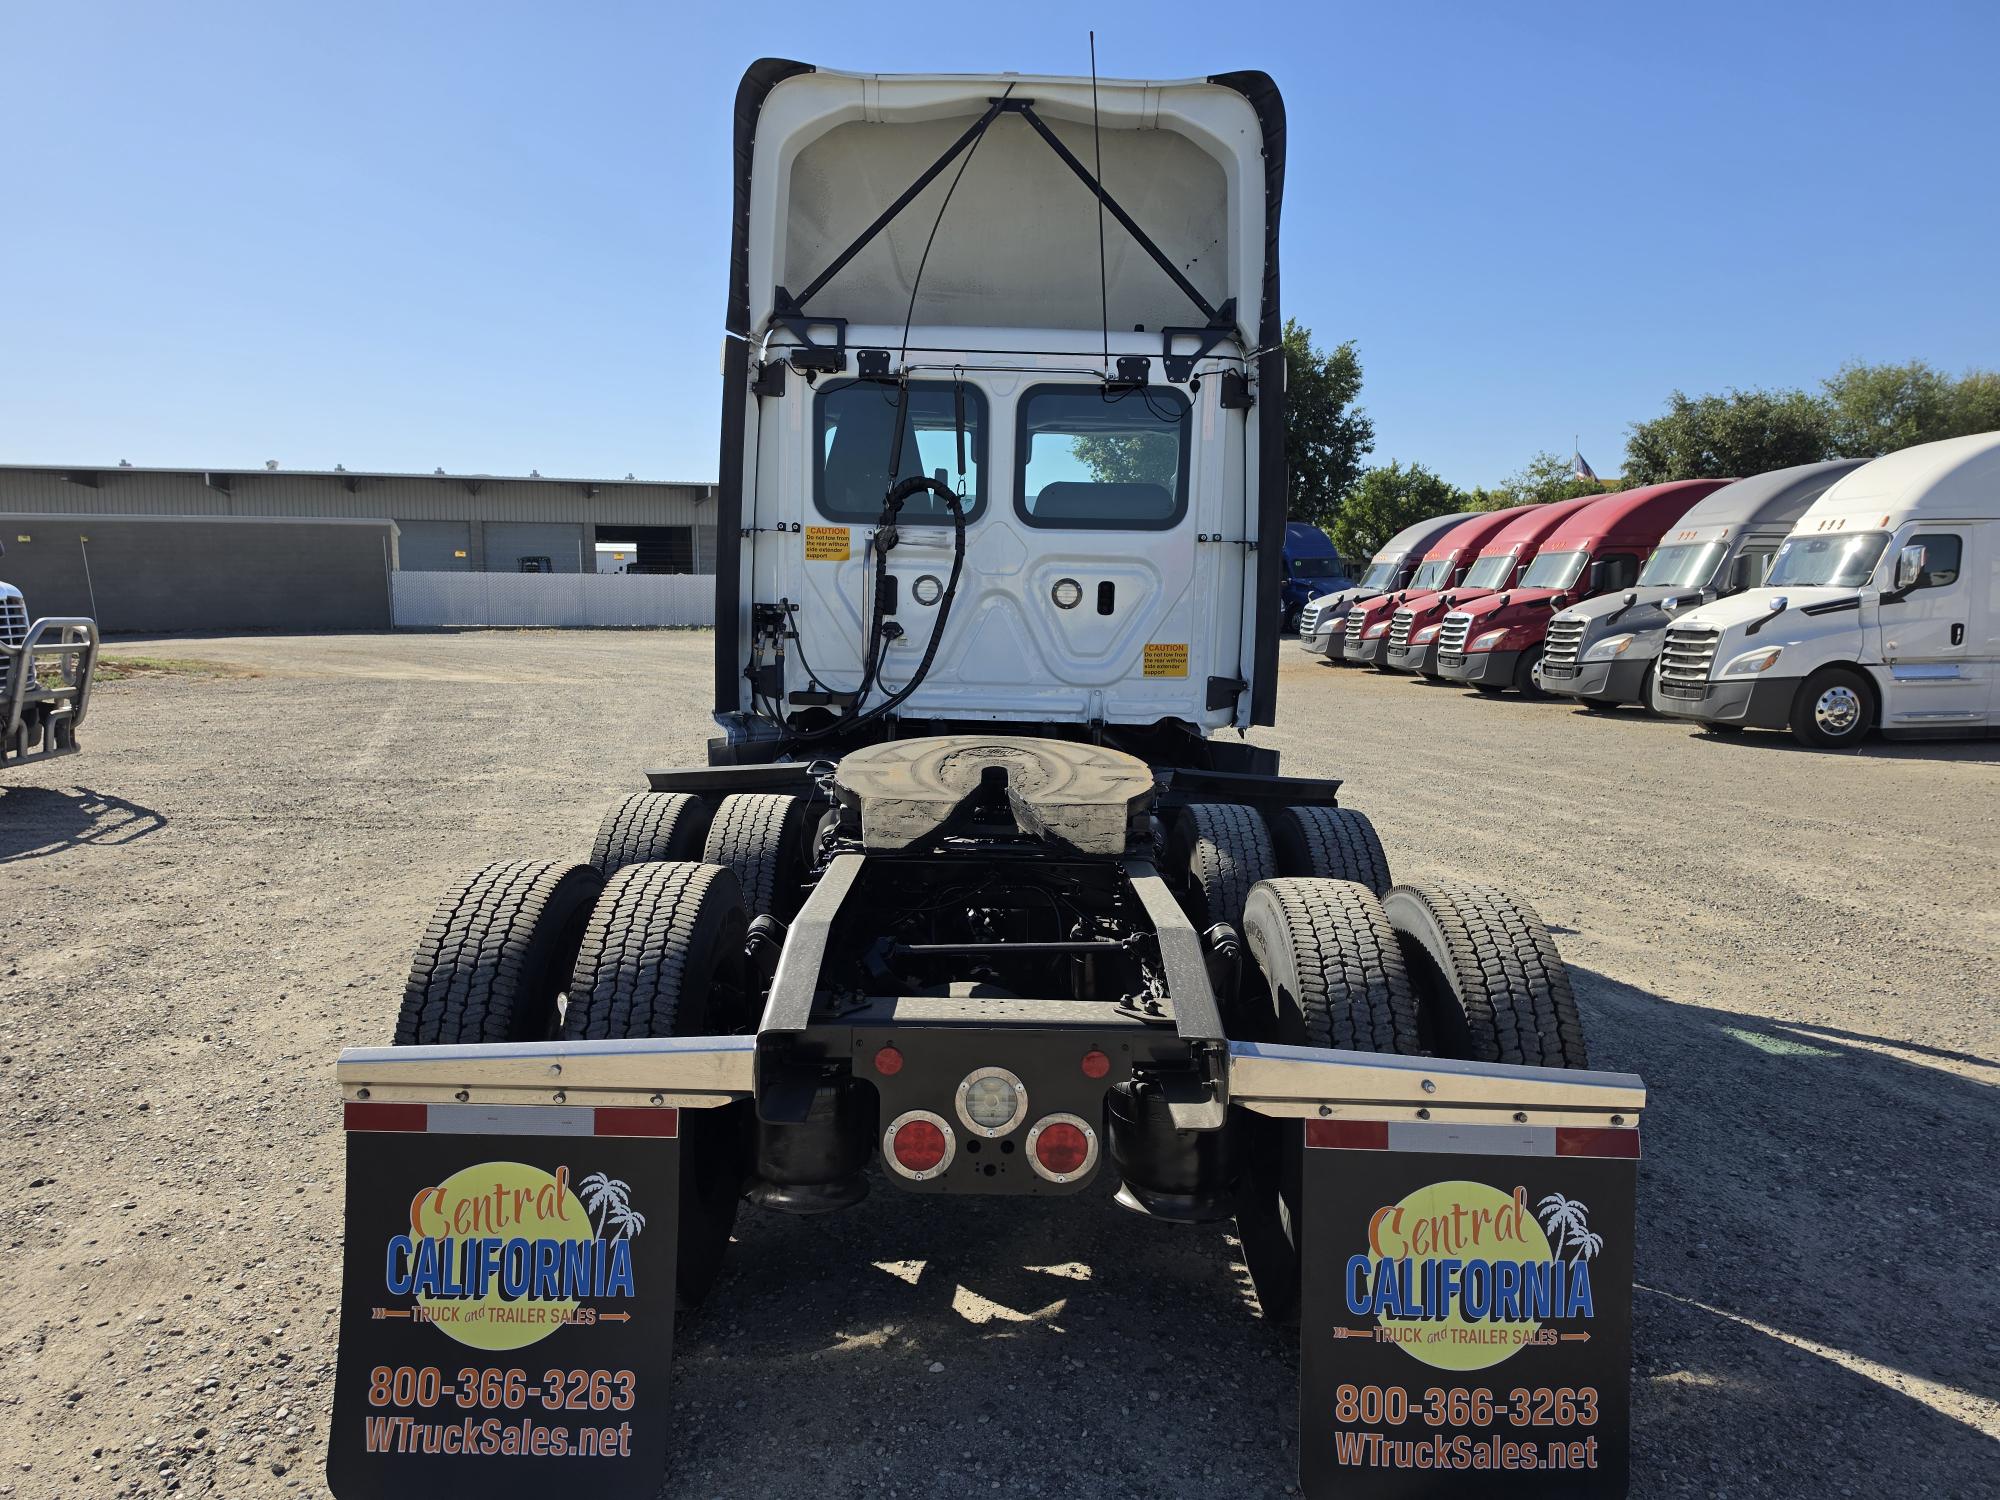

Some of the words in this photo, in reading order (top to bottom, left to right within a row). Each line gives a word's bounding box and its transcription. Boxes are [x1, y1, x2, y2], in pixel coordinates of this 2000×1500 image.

[410, 1165, 570, 1242] Central
[1368, 1185, 1529, 1262] Central
[386, 1235, 634, 1300] CALIFORNIA
[1346, 1254, 1594, 1320] CALIFORNIA
[412, 1306, 459, 1322] TRUCK
[464, 1303, 485, 1322] and
[488, 1308, 545, 1323] TRAILER
[551, 1308, 596, 1324] SALES
[1374, 1326, 1422, 1343] TRUCK
[1427, 1324, 1448, 1344] and
[1451, 1328, 1508, 1344] TRAILER
[1512, 1329, 1558, 1345] SALES
[368, 1366, 636, 1411] 800-366-3263
[1335, 1384, 1599, 1426] 800-366-3263
[366, 1416, 632, 1457] WTruckSales.net
[1335, 1432, 1598, 1469] WTruckSales.net
